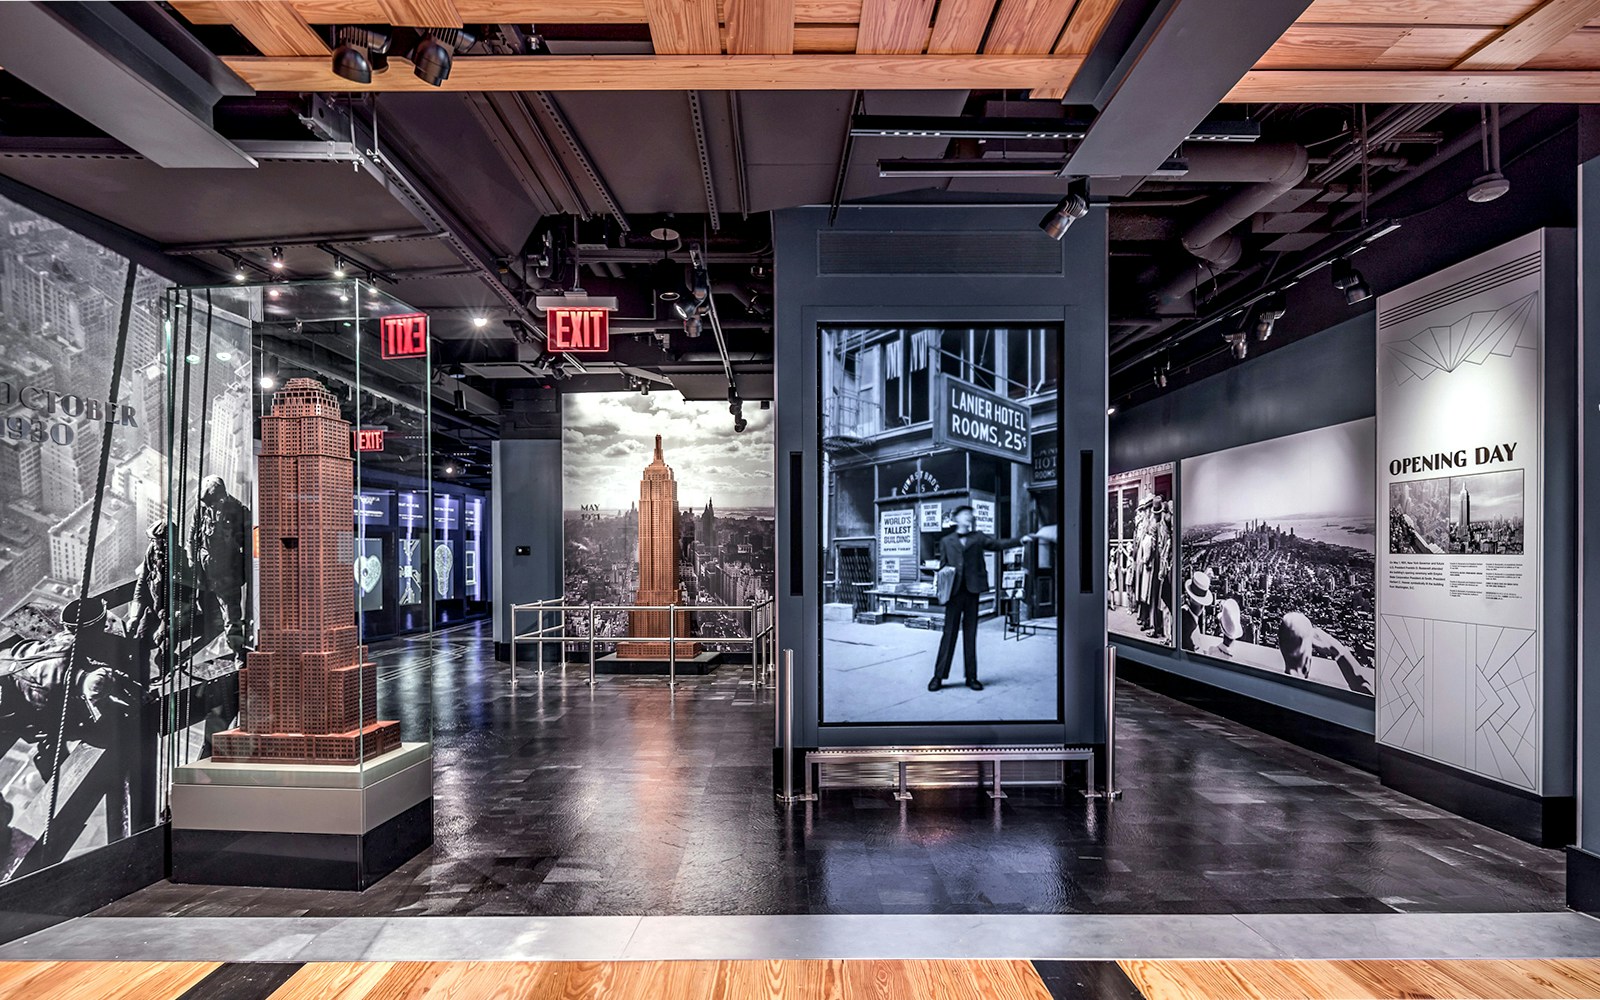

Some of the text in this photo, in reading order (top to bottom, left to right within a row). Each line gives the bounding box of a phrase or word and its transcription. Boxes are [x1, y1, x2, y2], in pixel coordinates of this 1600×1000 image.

[556, 311, 603, 348] EXIT
[951, 388, 1027, 432] LANIER HOTEL
[951, 413, 1003, 448] ROOMS,
[359, 431, 381, 450] EXIT
[1389, 442, 1518, 476] OPENING DAY
[580, 503, 600, 511] MAY
[884, 516, 912, 526] WORLD'S
[884, 526, 911, 535] TALLEST
[883, 535, 911, 545] BUILDING
